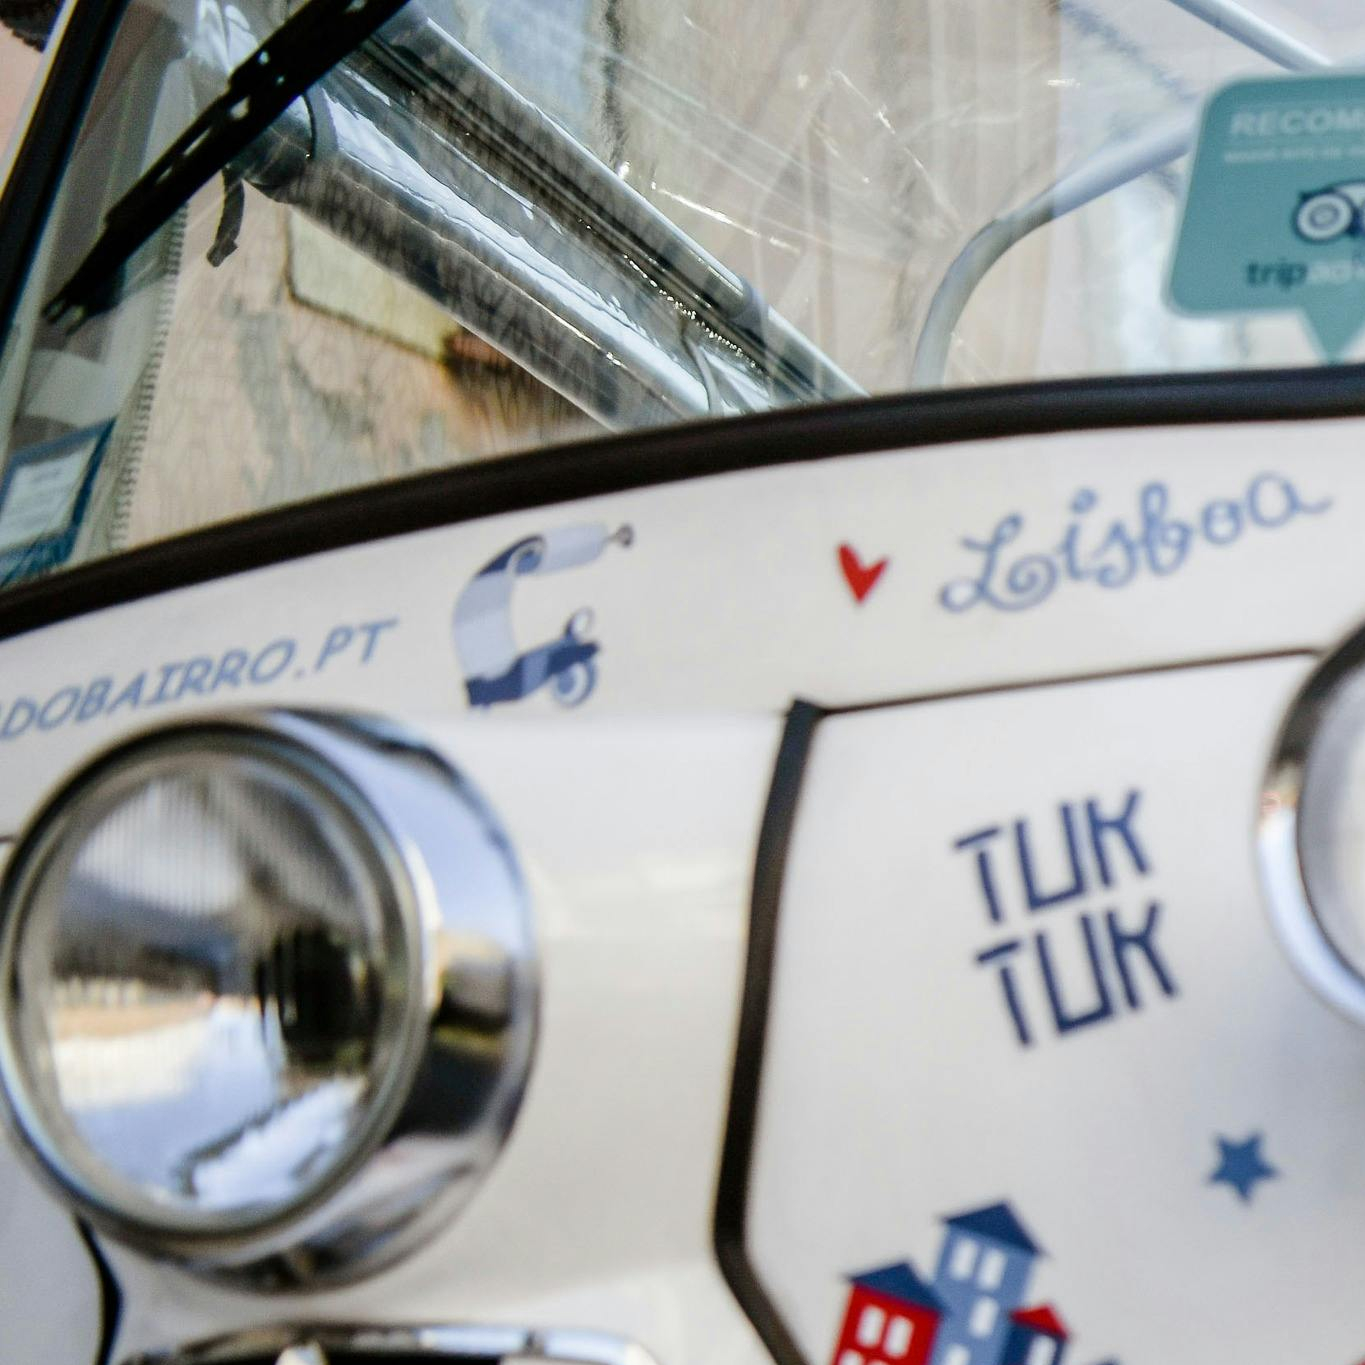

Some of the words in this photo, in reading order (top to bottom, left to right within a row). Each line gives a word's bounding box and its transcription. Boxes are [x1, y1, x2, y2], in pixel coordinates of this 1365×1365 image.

[938, 471, 1334, 614] Lisboa
[953, 788, 1152, 926] TUK
[975, 899, 1180, 1047] TUK
